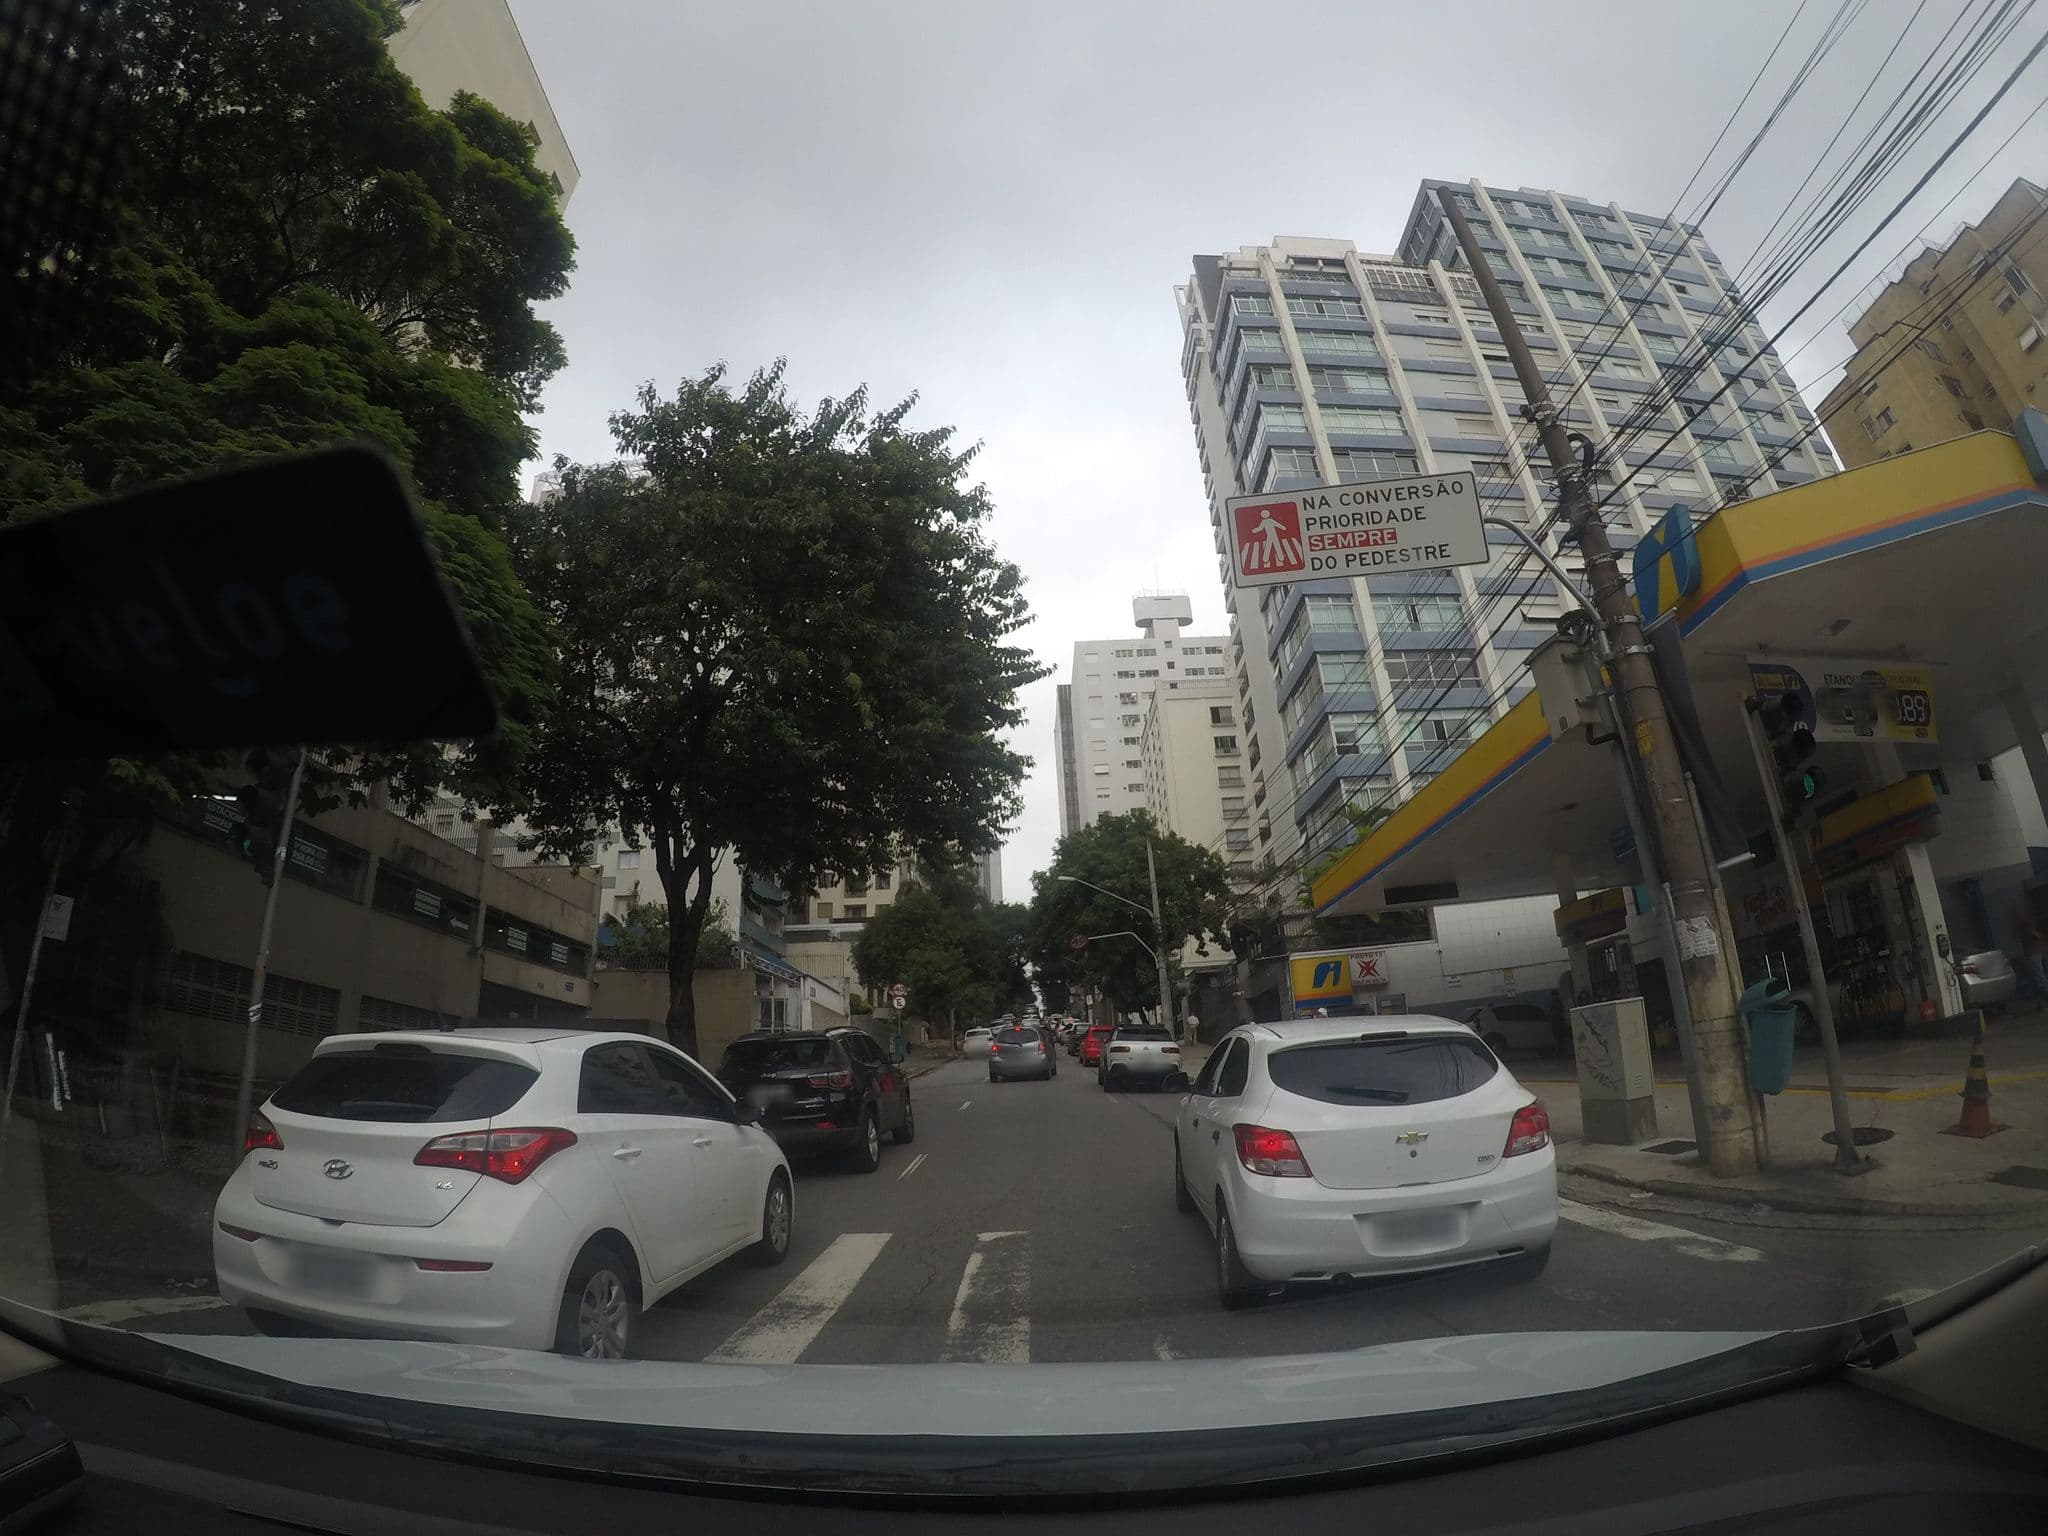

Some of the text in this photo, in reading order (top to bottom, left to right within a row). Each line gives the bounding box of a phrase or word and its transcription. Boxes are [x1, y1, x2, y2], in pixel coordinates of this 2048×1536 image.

[1302, 480, 1464, 511] NA CONVERSÃO
[1305, 506, 1427, 532] PRIORIDADE
[1309, 528, 1397, 552] SEMPRE
[1310, 544, 1452, 572] DO PEDESTRE
